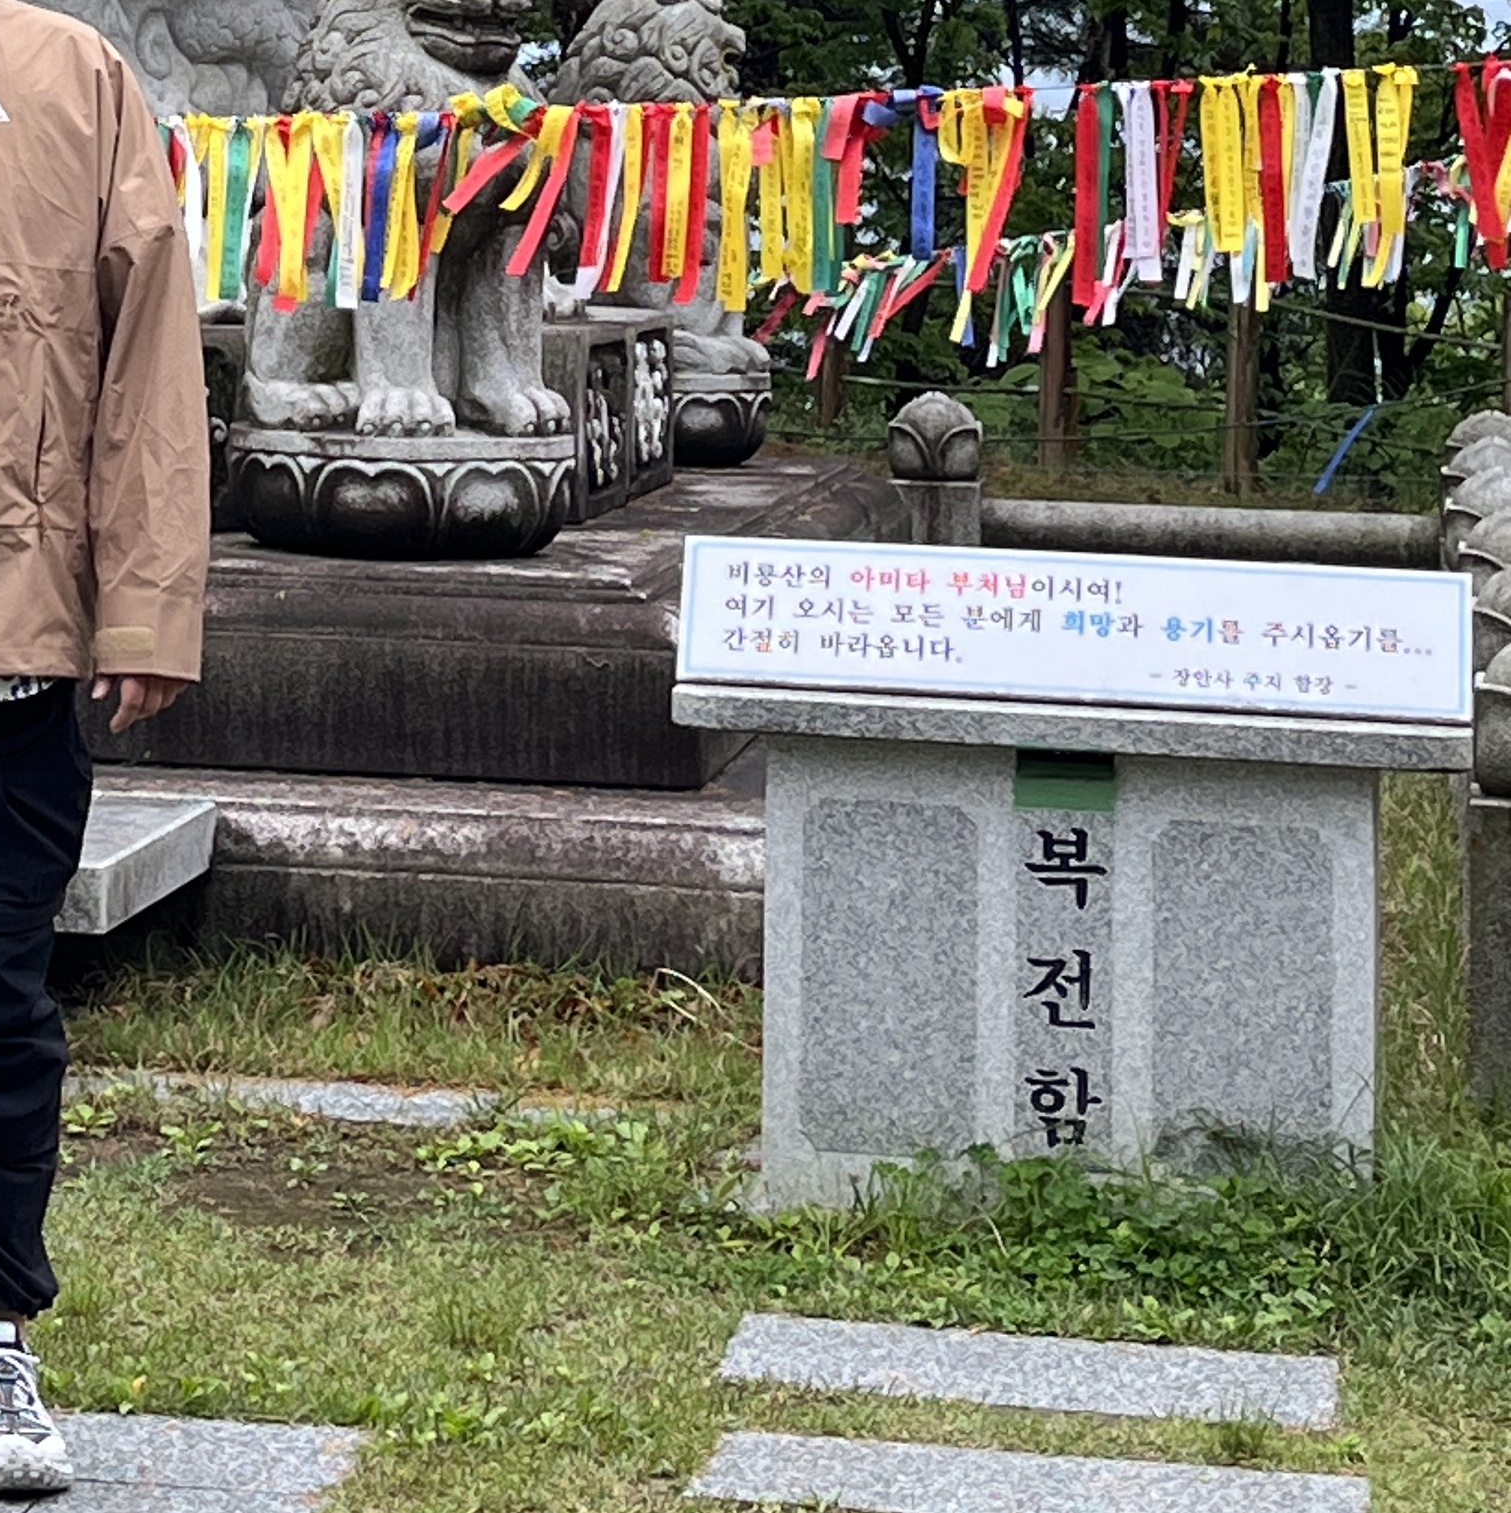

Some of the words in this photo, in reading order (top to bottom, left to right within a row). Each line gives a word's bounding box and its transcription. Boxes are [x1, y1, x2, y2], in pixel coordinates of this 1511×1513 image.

[850, 565, 931, 594] 아미타
[947, 571, 1122, 605] 부처님이시여!
[725, 594, 775, 621] 여기
[793, 597, 874, 625] 오시는
[890, 603, 944, 629] 모든
[961, 605, 1042, 633] 분에게
[1061, 609, 1144, 639] 희망과
[1160, 616, 1245, 645] 용기를
[1260, 621, 1432, 656] 주시옵기를...
[722, 626, 799, 654] 간절히
[820, 631, 963, 663] 바라옵니다.
[1172, 668, 1235, 689] 장안사
[1243, 671, 1282, 691] 주지
